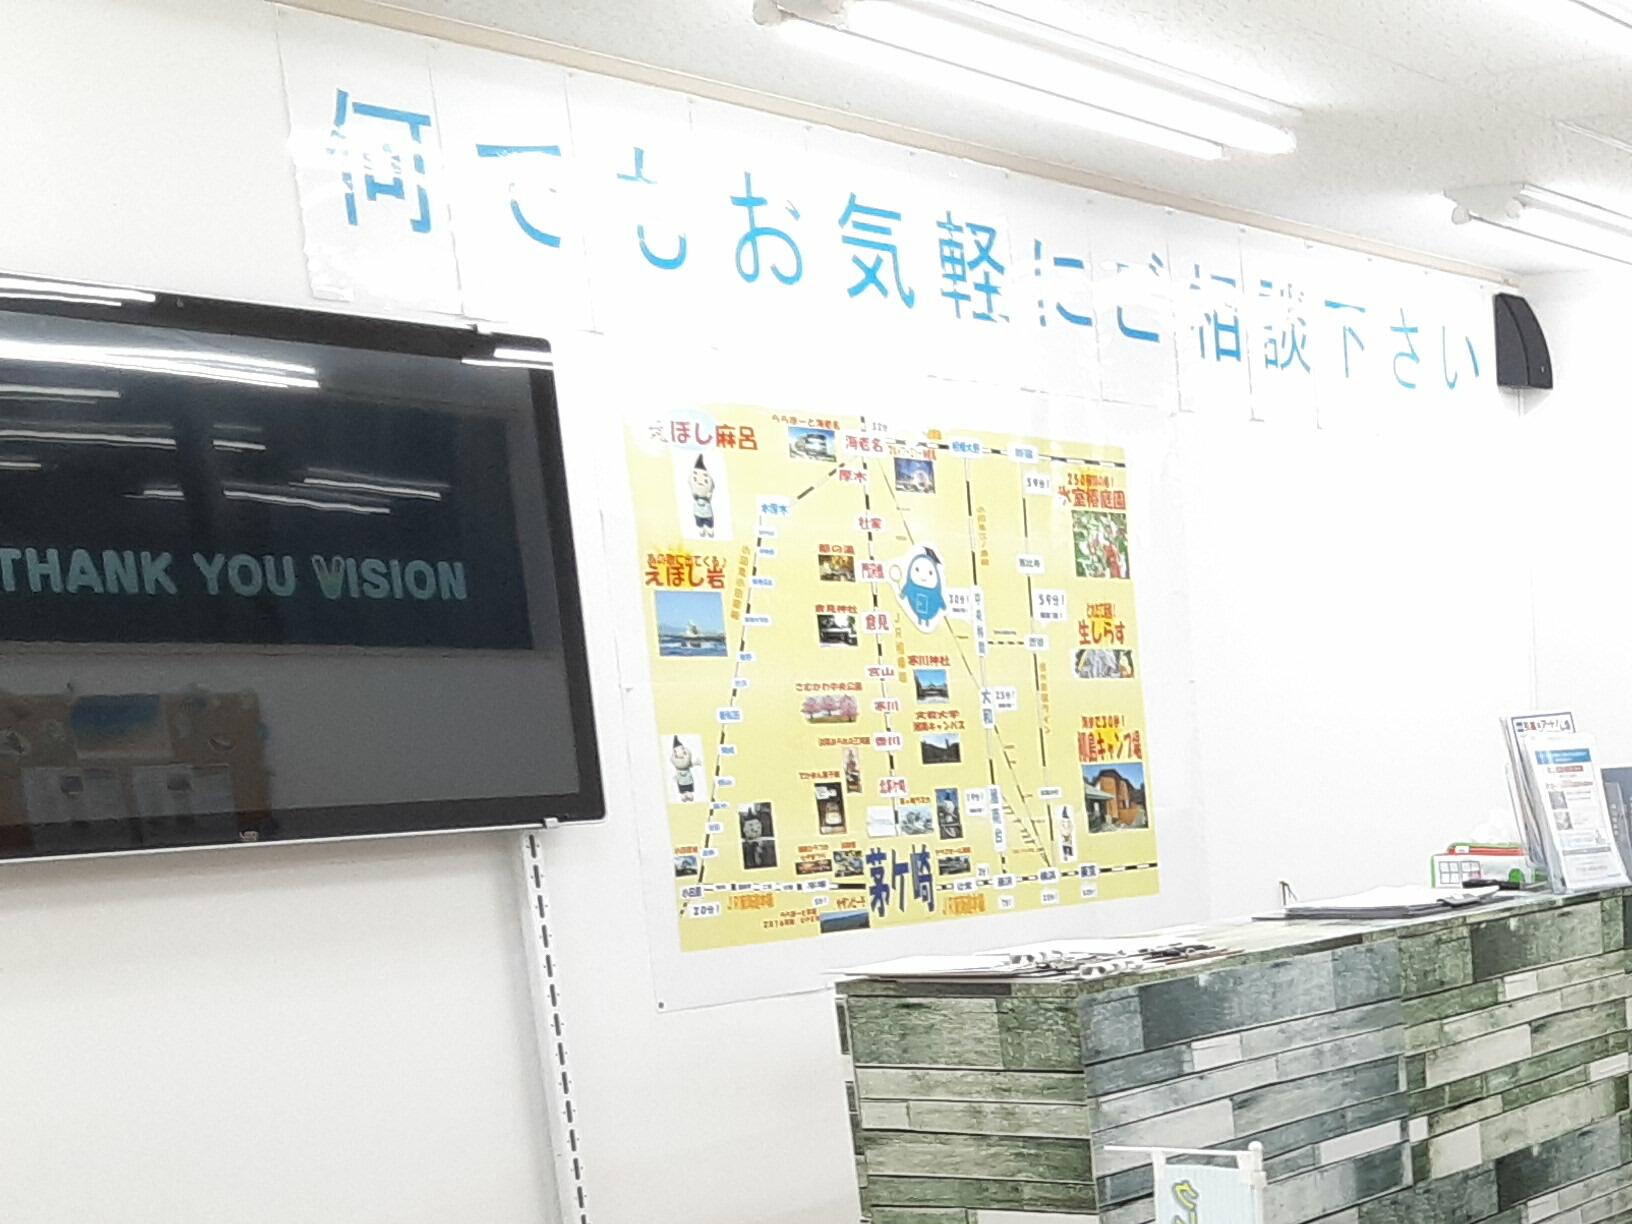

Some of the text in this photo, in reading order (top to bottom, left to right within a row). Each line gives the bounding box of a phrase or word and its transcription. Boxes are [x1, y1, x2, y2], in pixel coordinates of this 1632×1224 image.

[845, 434, 884, 453] 海老名
[0, 547, 469, 601] THANK YOU VISION
[865, 613, 890, 631] 倉見
[1078, 620, 1126, 646] 生しらす
